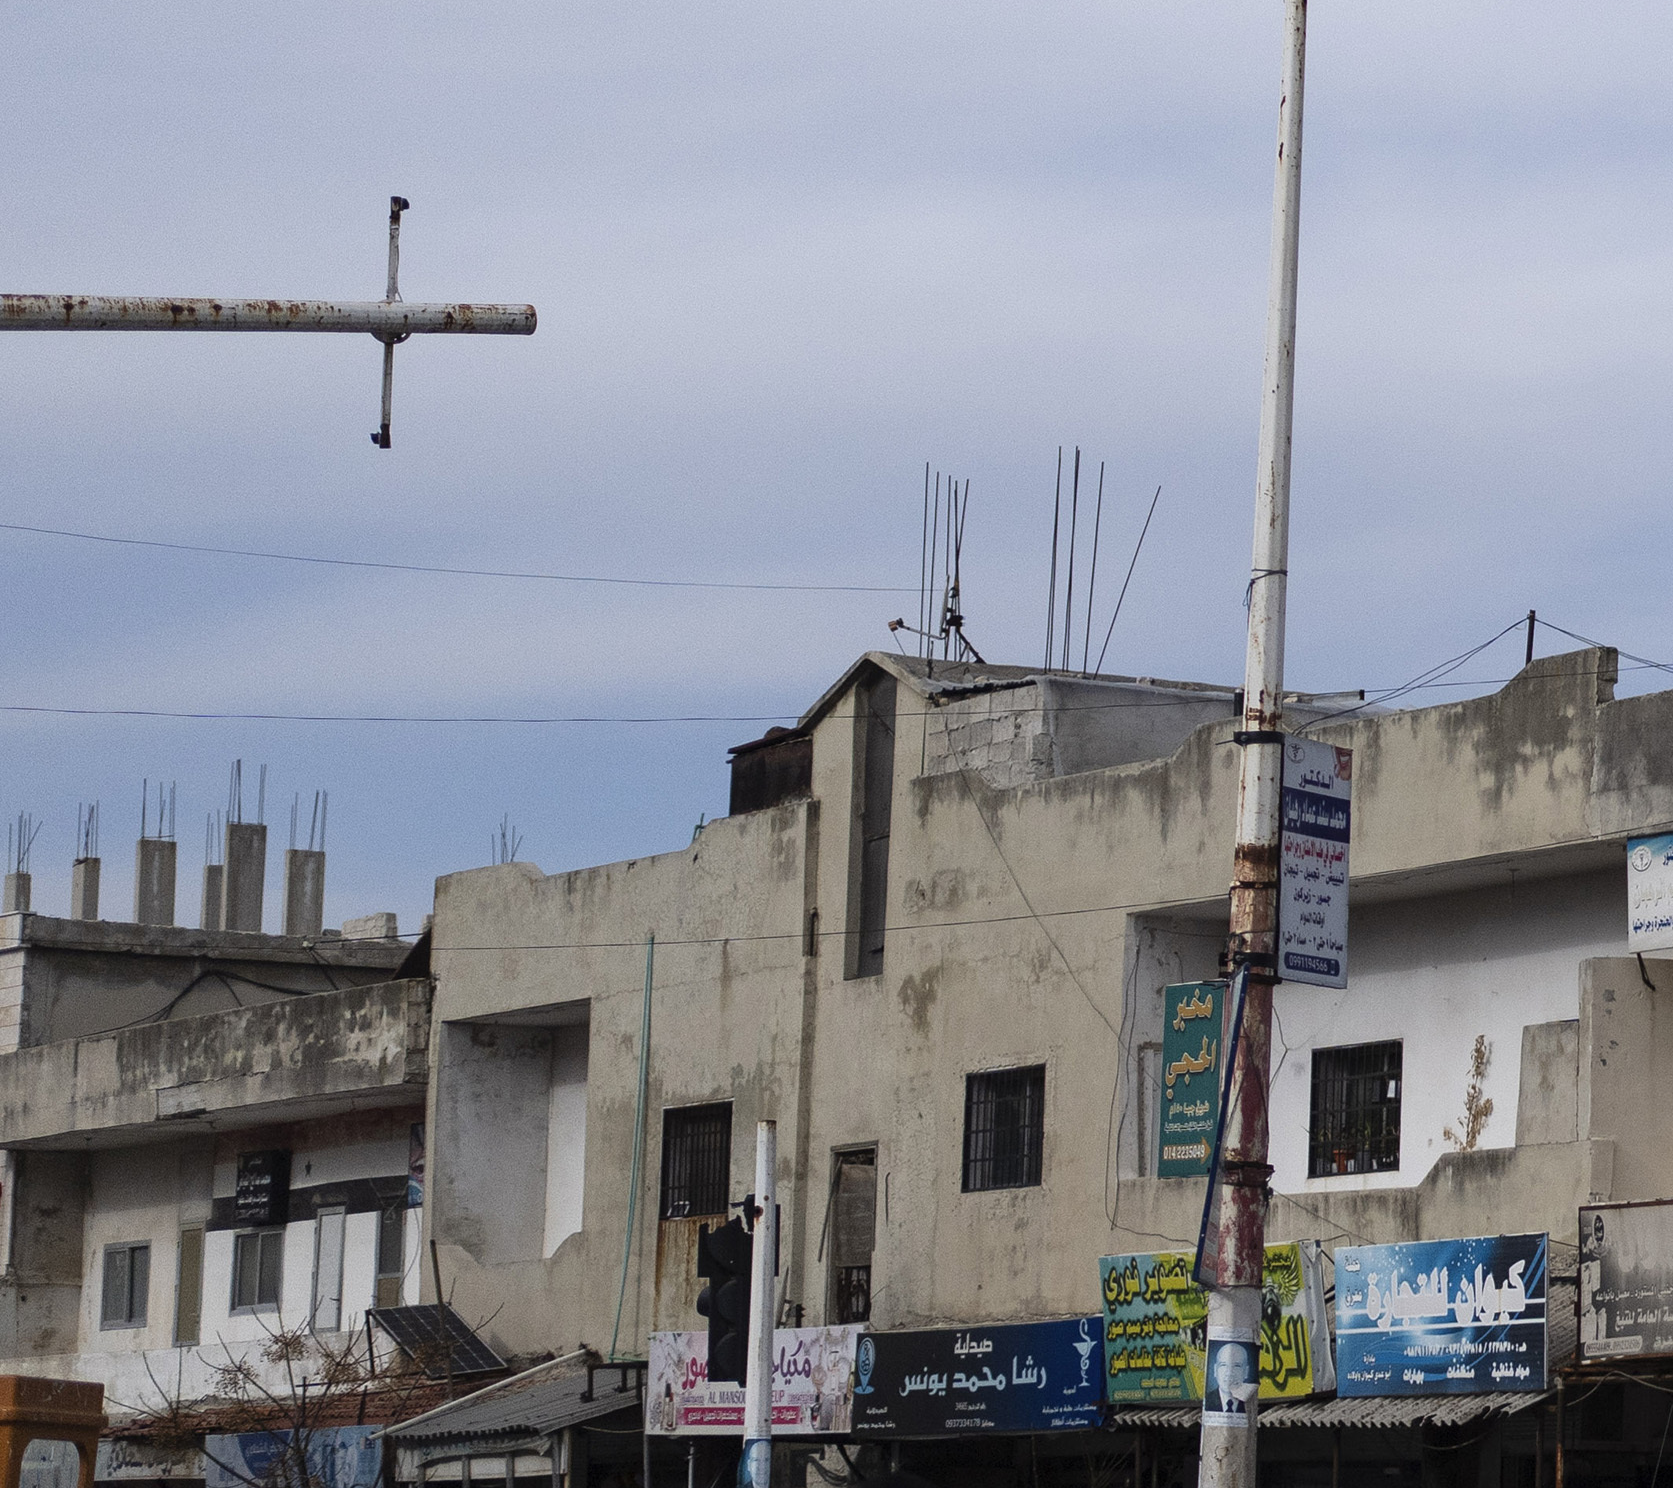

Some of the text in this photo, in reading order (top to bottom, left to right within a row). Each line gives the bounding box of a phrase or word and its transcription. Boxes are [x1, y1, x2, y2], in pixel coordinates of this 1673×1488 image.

[1173, 988, 1213, 1031] مخبر
[1104, 1257, 1190, 1313] تصوير فوري
[1367, 1259, 1525, 1329] كيوان للتجارة
[954, 1333, 993, 1358] صيدلية
[899, 1355, 1046, 1396] رشا محمد يونس
[707, 1391, 717, 1403] AL
